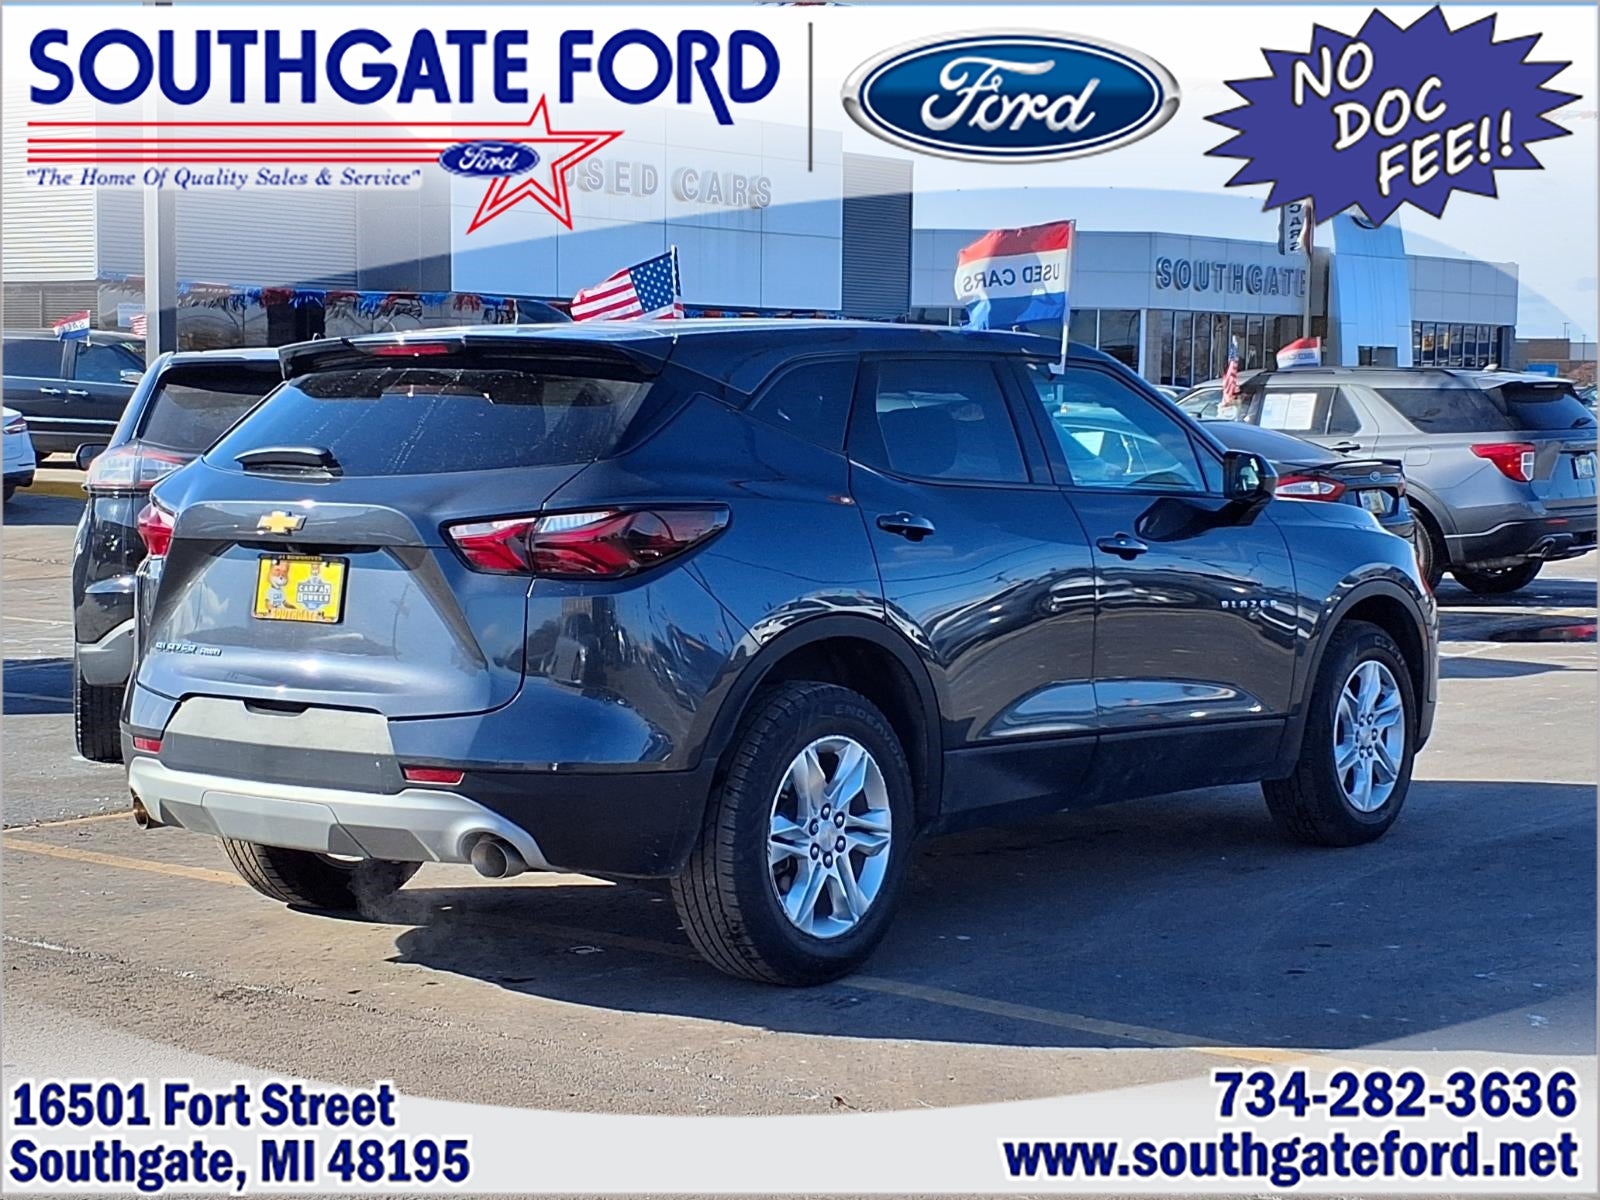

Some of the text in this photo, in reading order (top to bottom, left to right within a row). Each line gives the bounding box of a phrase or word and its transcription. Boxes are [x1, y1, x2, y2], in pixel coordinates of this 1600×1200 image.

[550, 155, 773, 209] USED CARS
[1156, 256, 1306, 297] SOUTHGATE
[1221, 599, 1278, 609] BLAZER
